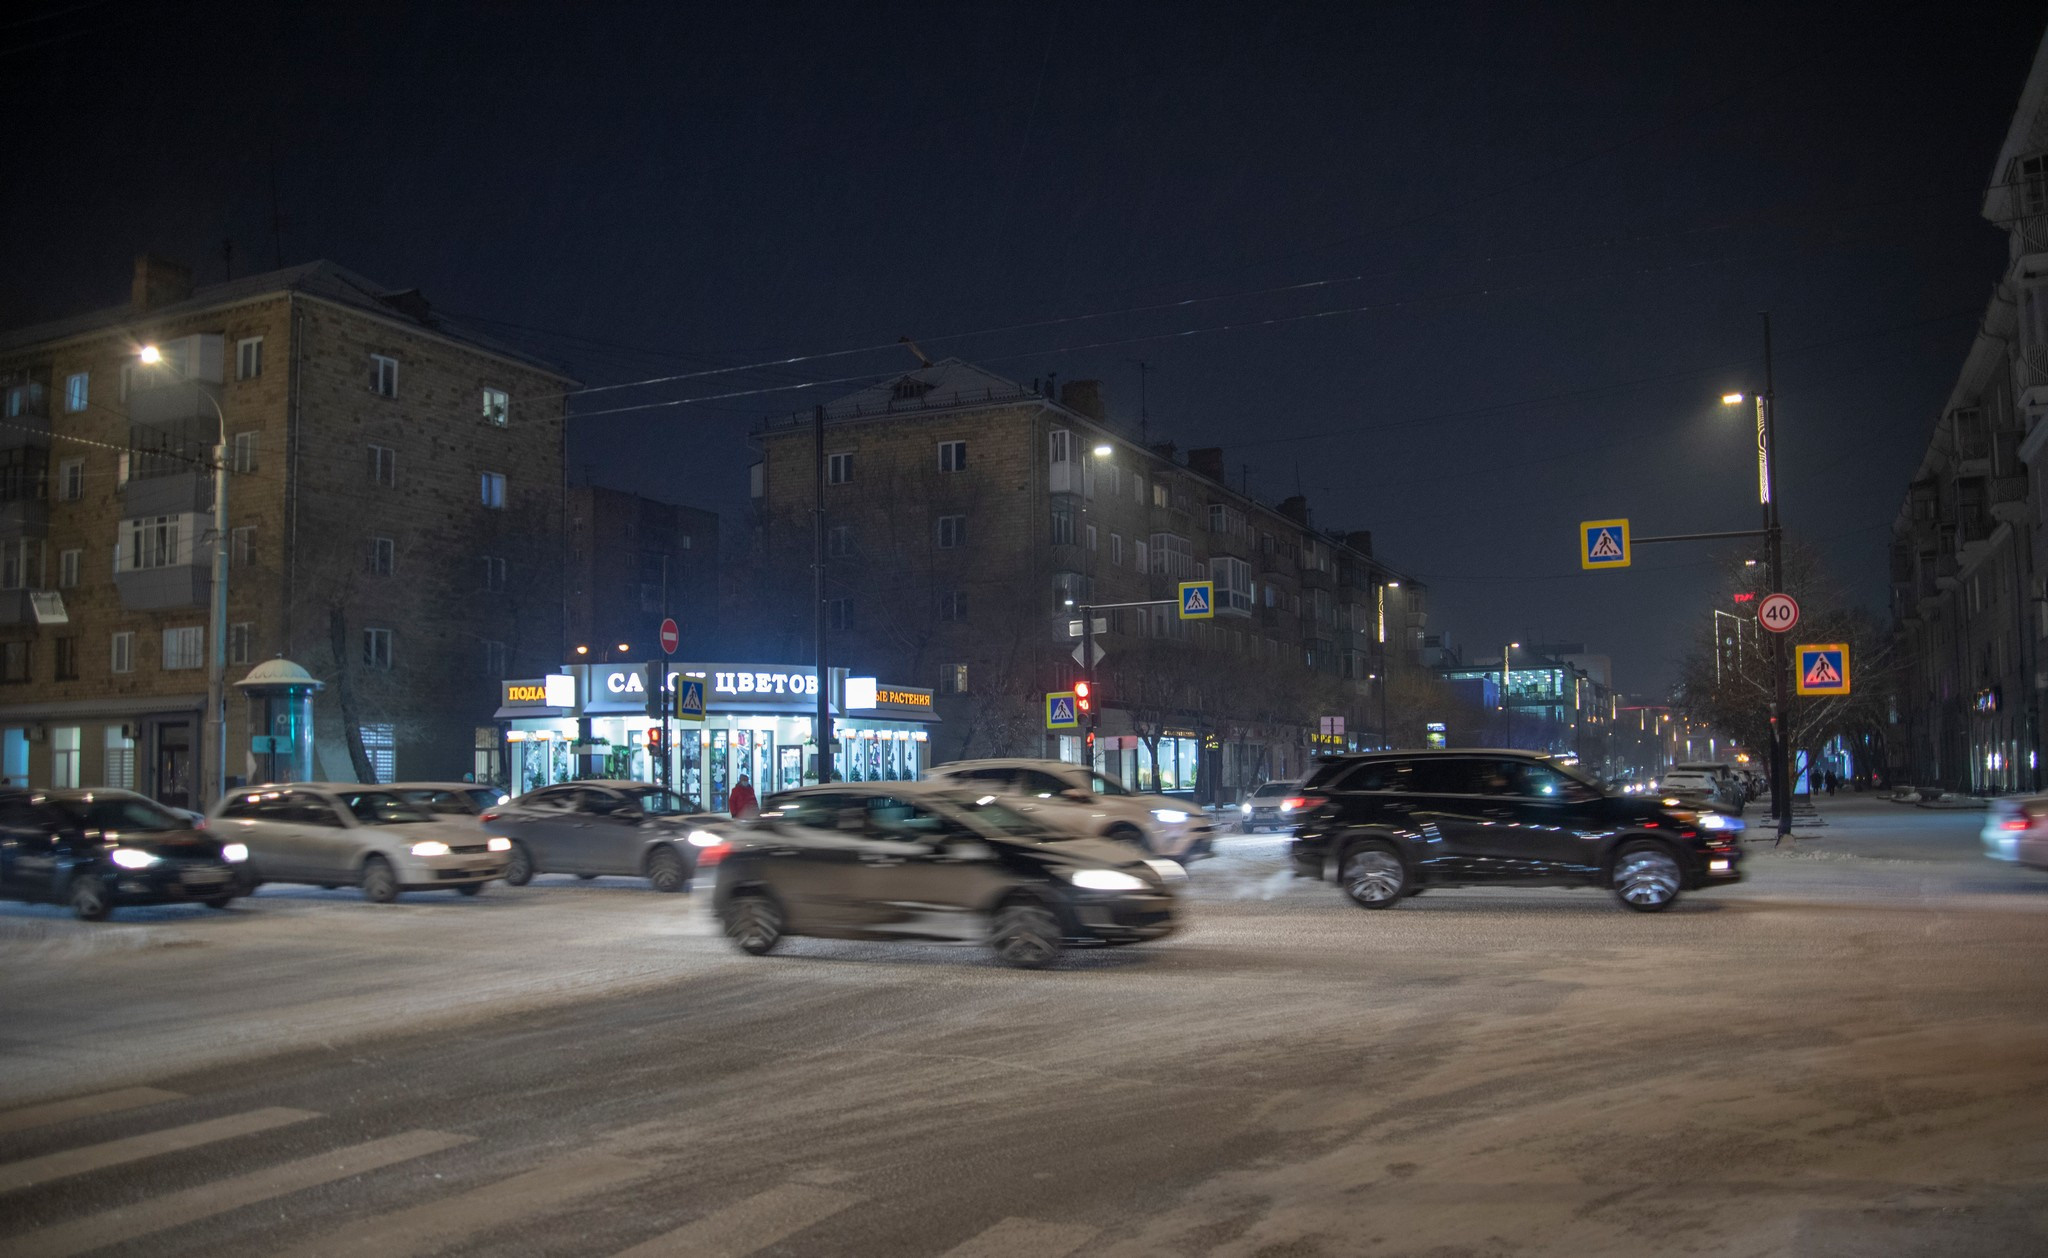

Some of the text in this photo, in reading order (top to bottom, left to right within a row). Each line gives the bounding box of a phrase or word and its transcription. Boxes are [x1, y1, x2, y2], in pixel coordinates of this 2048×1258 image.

[1766, 604, 1791, 621] 40
[715, 672, 819, 695] ЦВЕТОВ
[508, 686, 547, 701] ПОДА
[889, 691, 930, 706] РАСТЕНИЯ
